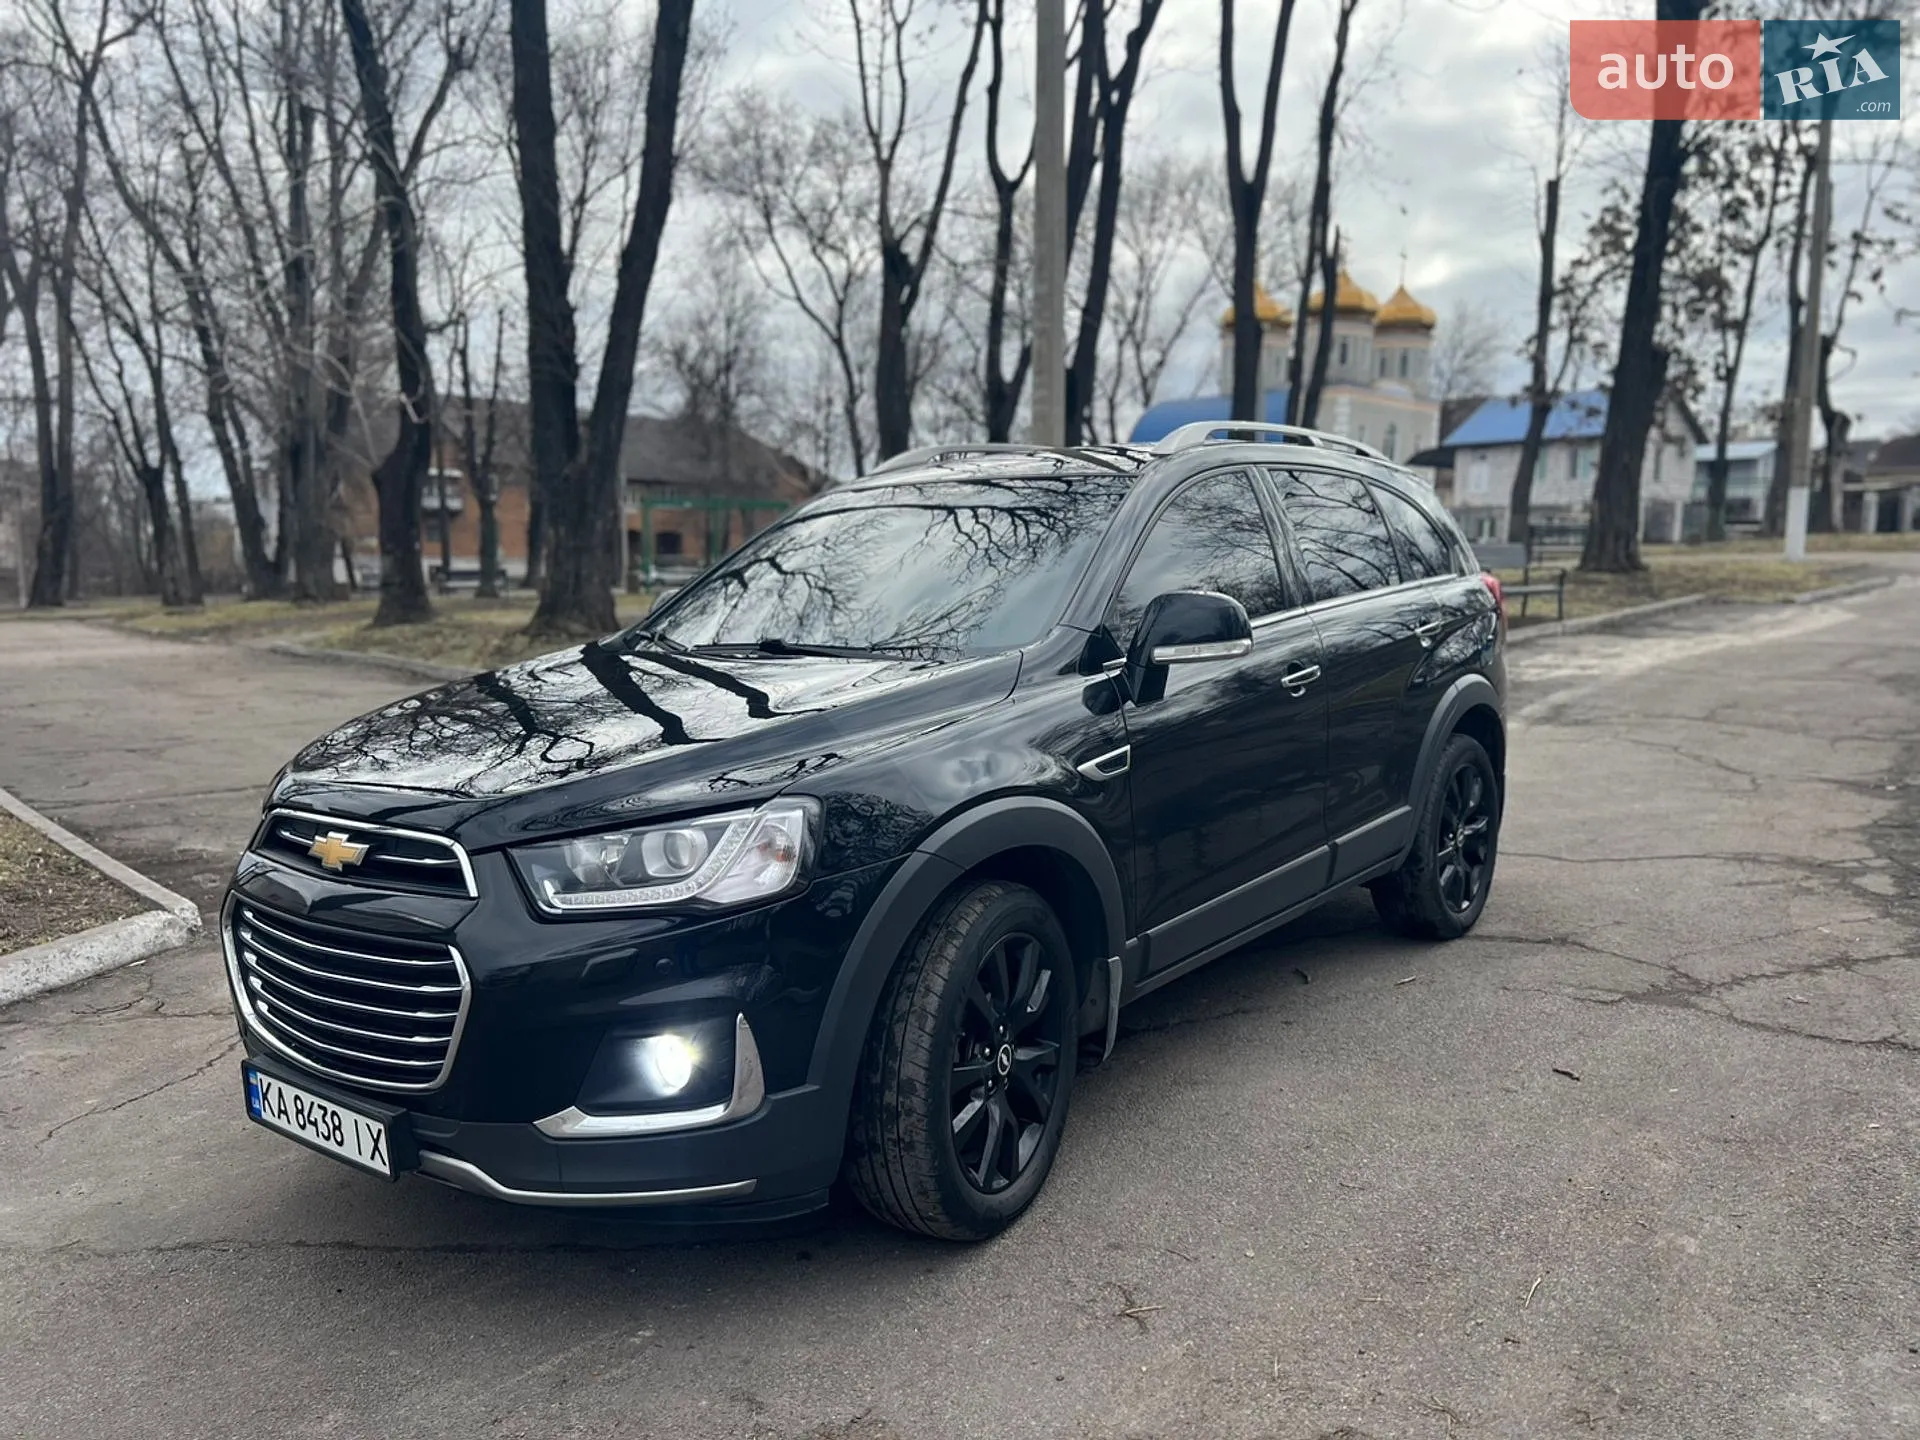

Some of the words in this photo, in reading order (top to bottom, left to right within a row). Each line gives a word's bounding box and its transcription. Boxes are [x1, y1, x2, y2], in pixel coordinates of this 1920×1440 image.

[259, 1078, 292, 1125] KA
[293, 1094, 345, 1147] 8438
[354, 1118, 387, 1166] IX
